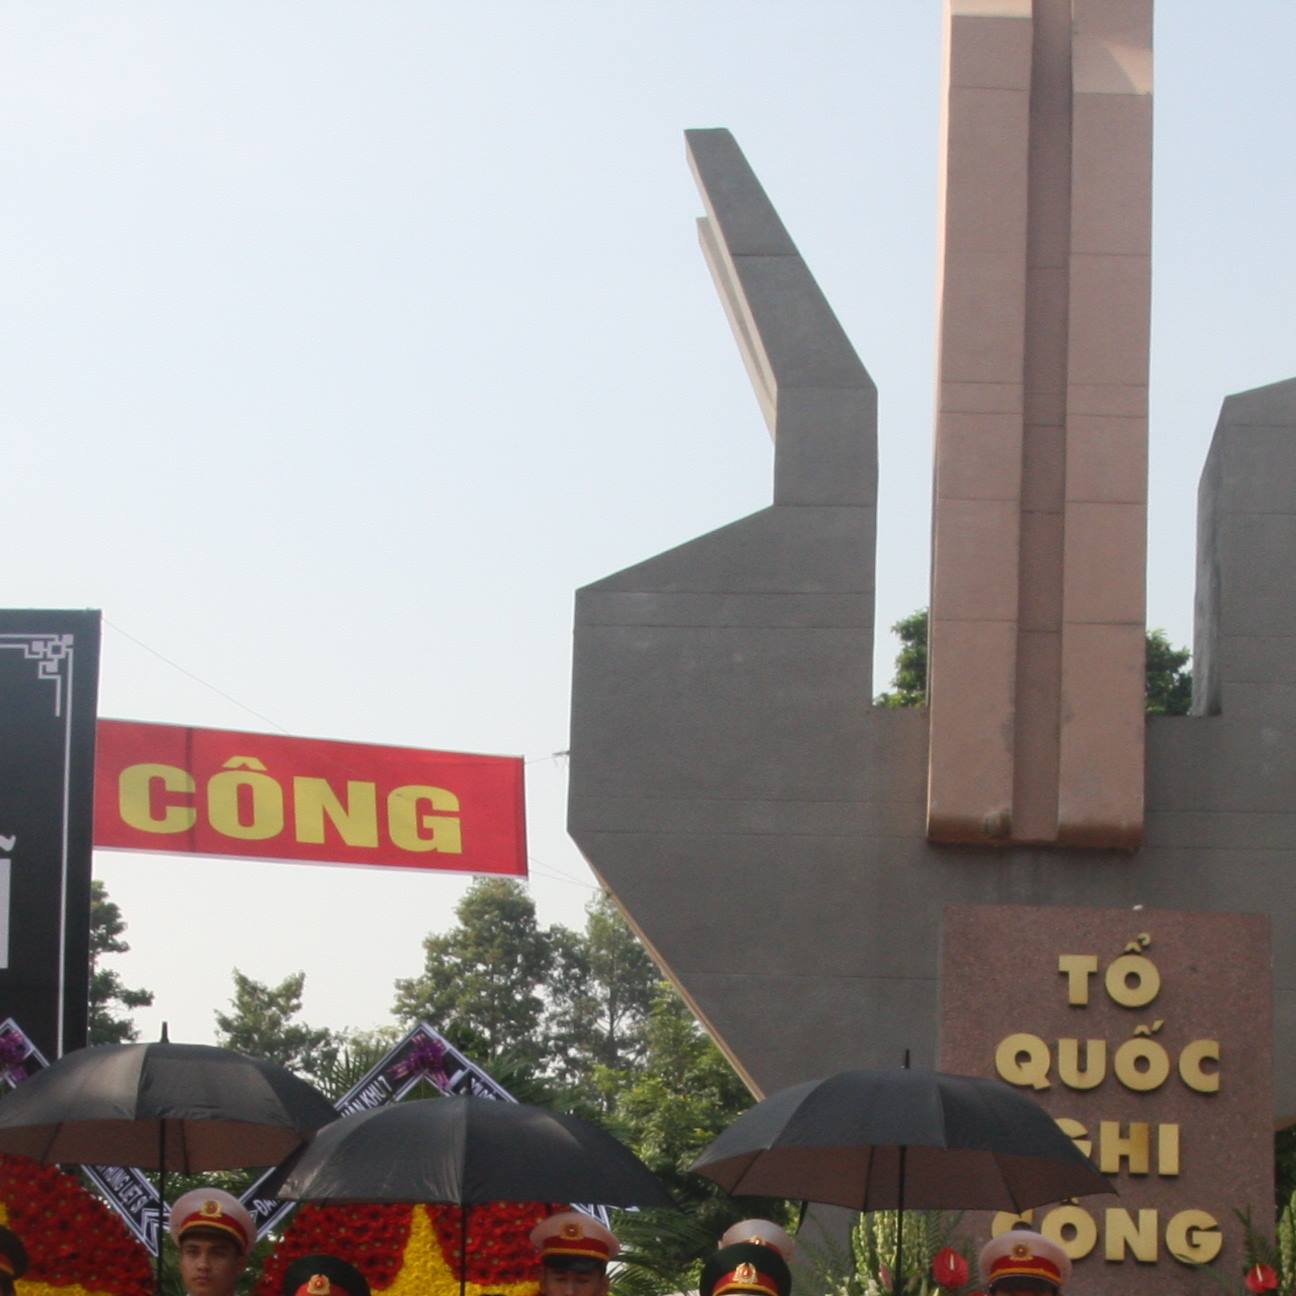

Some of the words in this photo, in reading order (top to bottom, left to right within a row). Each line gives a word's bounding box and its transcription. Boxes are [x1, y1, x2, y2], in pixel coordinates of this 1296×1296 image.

[118, 756, 463, 854] CÔNG
[1059, 932, 1160, 1007] TỔ
[995, 1019, 1220, 1092] QUỐC
